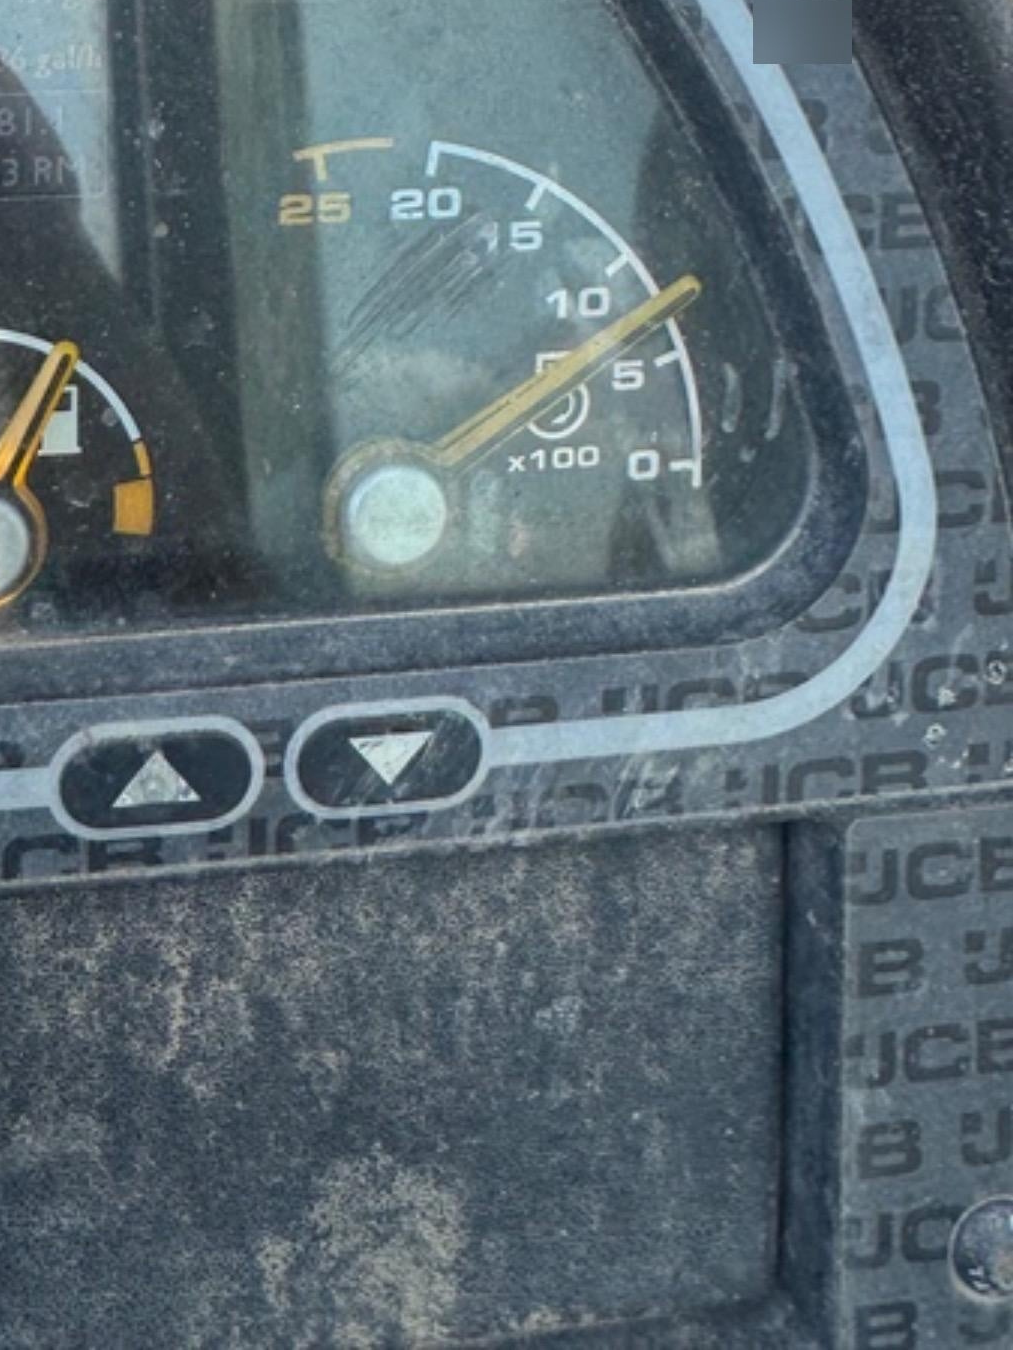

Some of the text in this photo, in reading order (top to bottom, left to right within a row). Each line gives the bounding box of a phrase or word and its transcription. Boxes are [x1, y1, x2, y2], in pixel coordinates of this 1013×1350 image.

[277, 191, 352, 227] 25
[390, 186, 463, 222] 20
[544, 286, 611, 320] 10
[611, 358, 646, 392] 5
[507, 445, 601, 473] x100
[627, 449, 661, 482] 0
